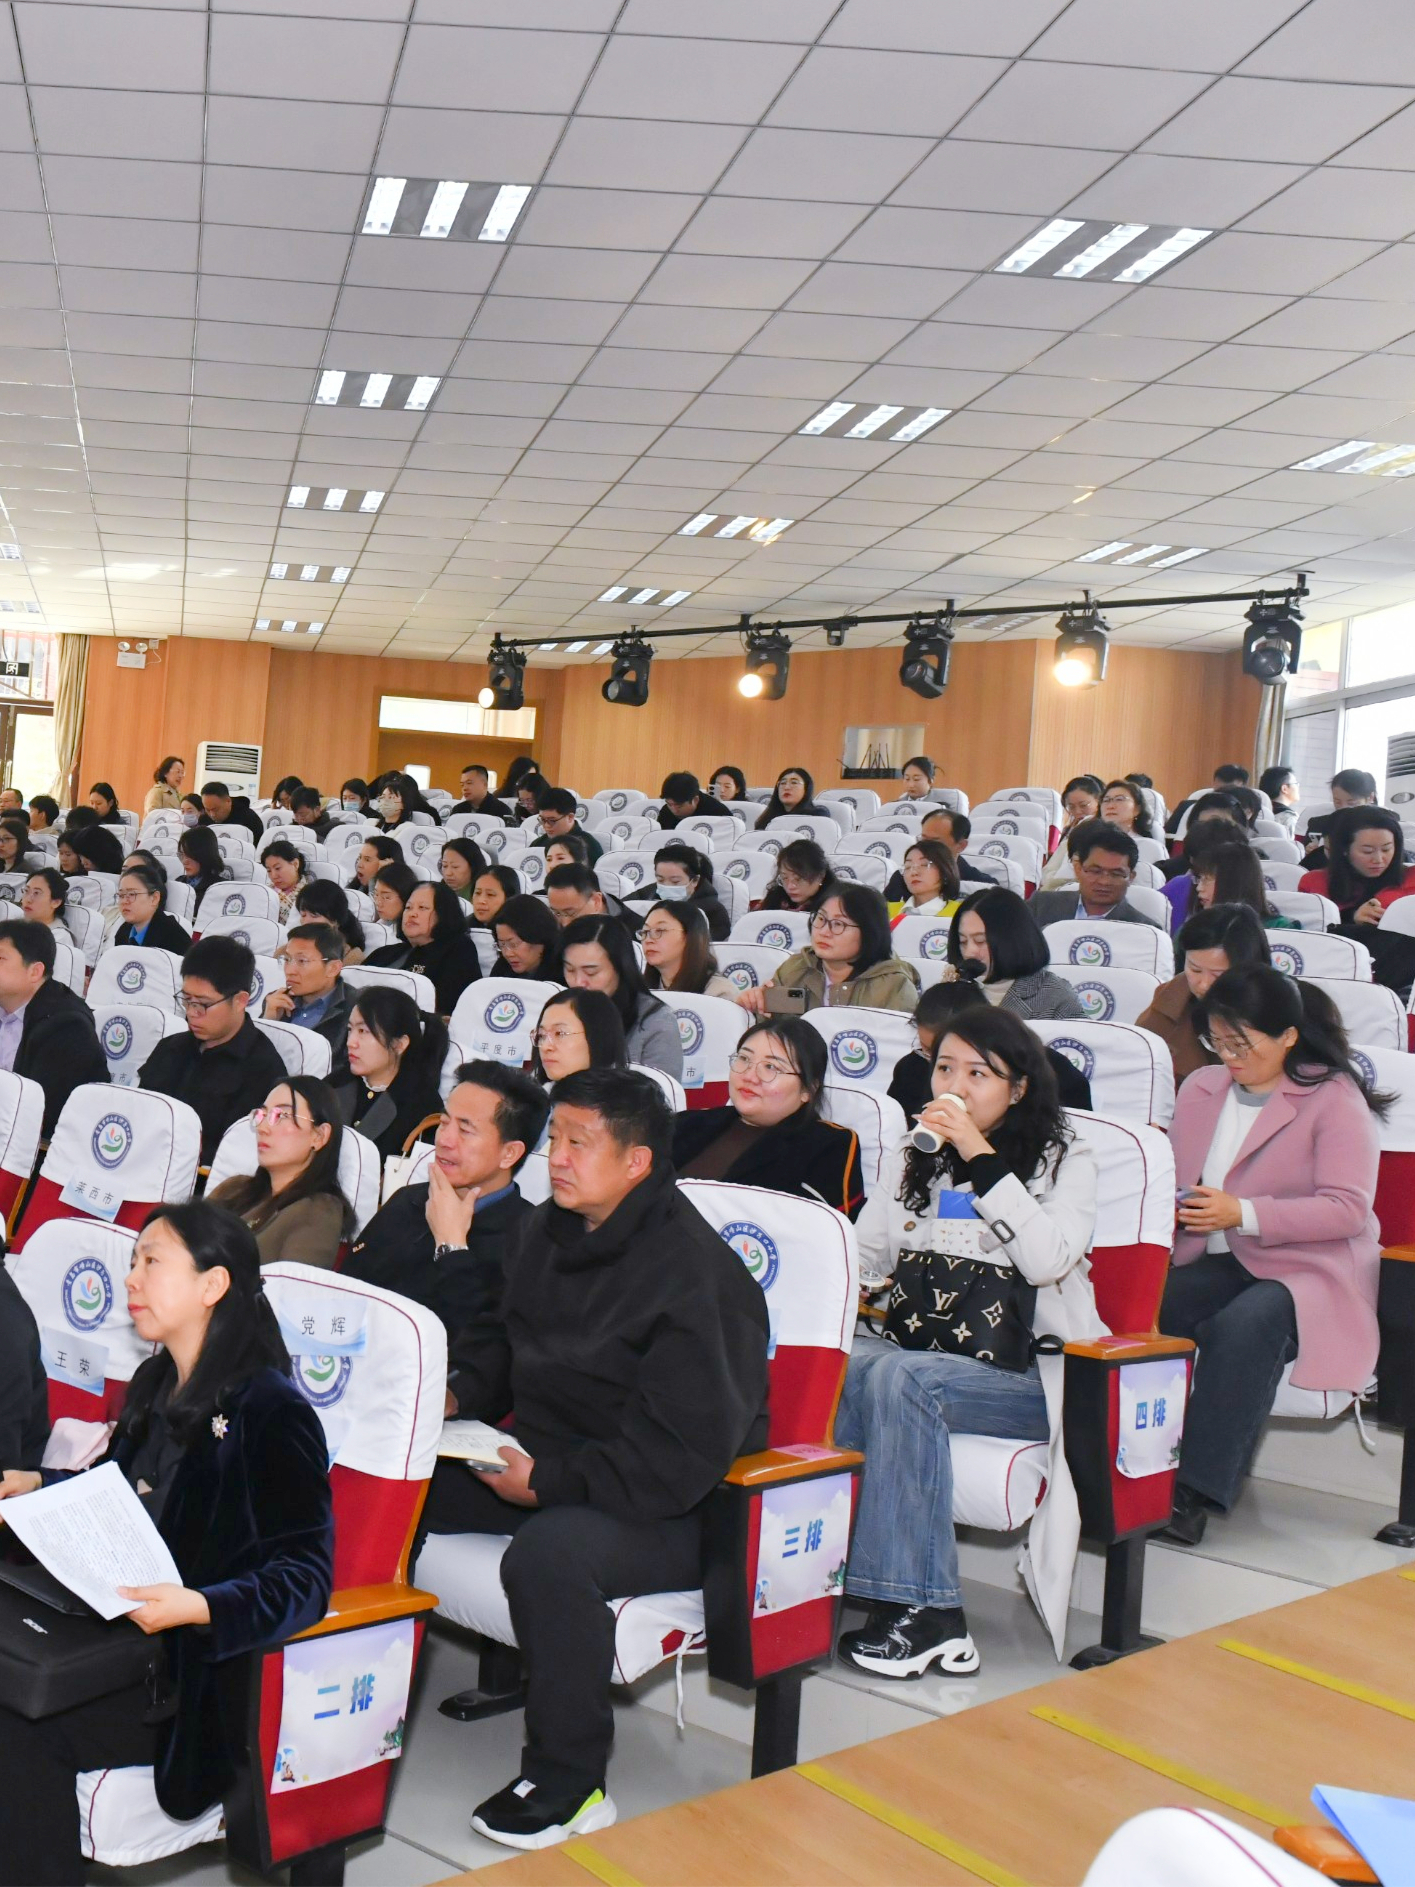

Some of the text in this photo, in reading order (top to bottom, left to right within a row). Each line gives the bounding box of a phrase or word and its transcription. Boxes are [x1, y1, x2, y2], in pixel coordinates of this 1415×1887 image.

[481, 1042, 517, 1056] 平度市
[75, 1181, 114, 1205] 莱西市
[301, 1316, 346, 1336] 党辉
[55, 1350, 91, 1376] 王荣
[1135, 1397, 1167, 1430] 四排
[782, 1518, 824, 1558] 三排
[314, 1673, 375, 1720] 二排
